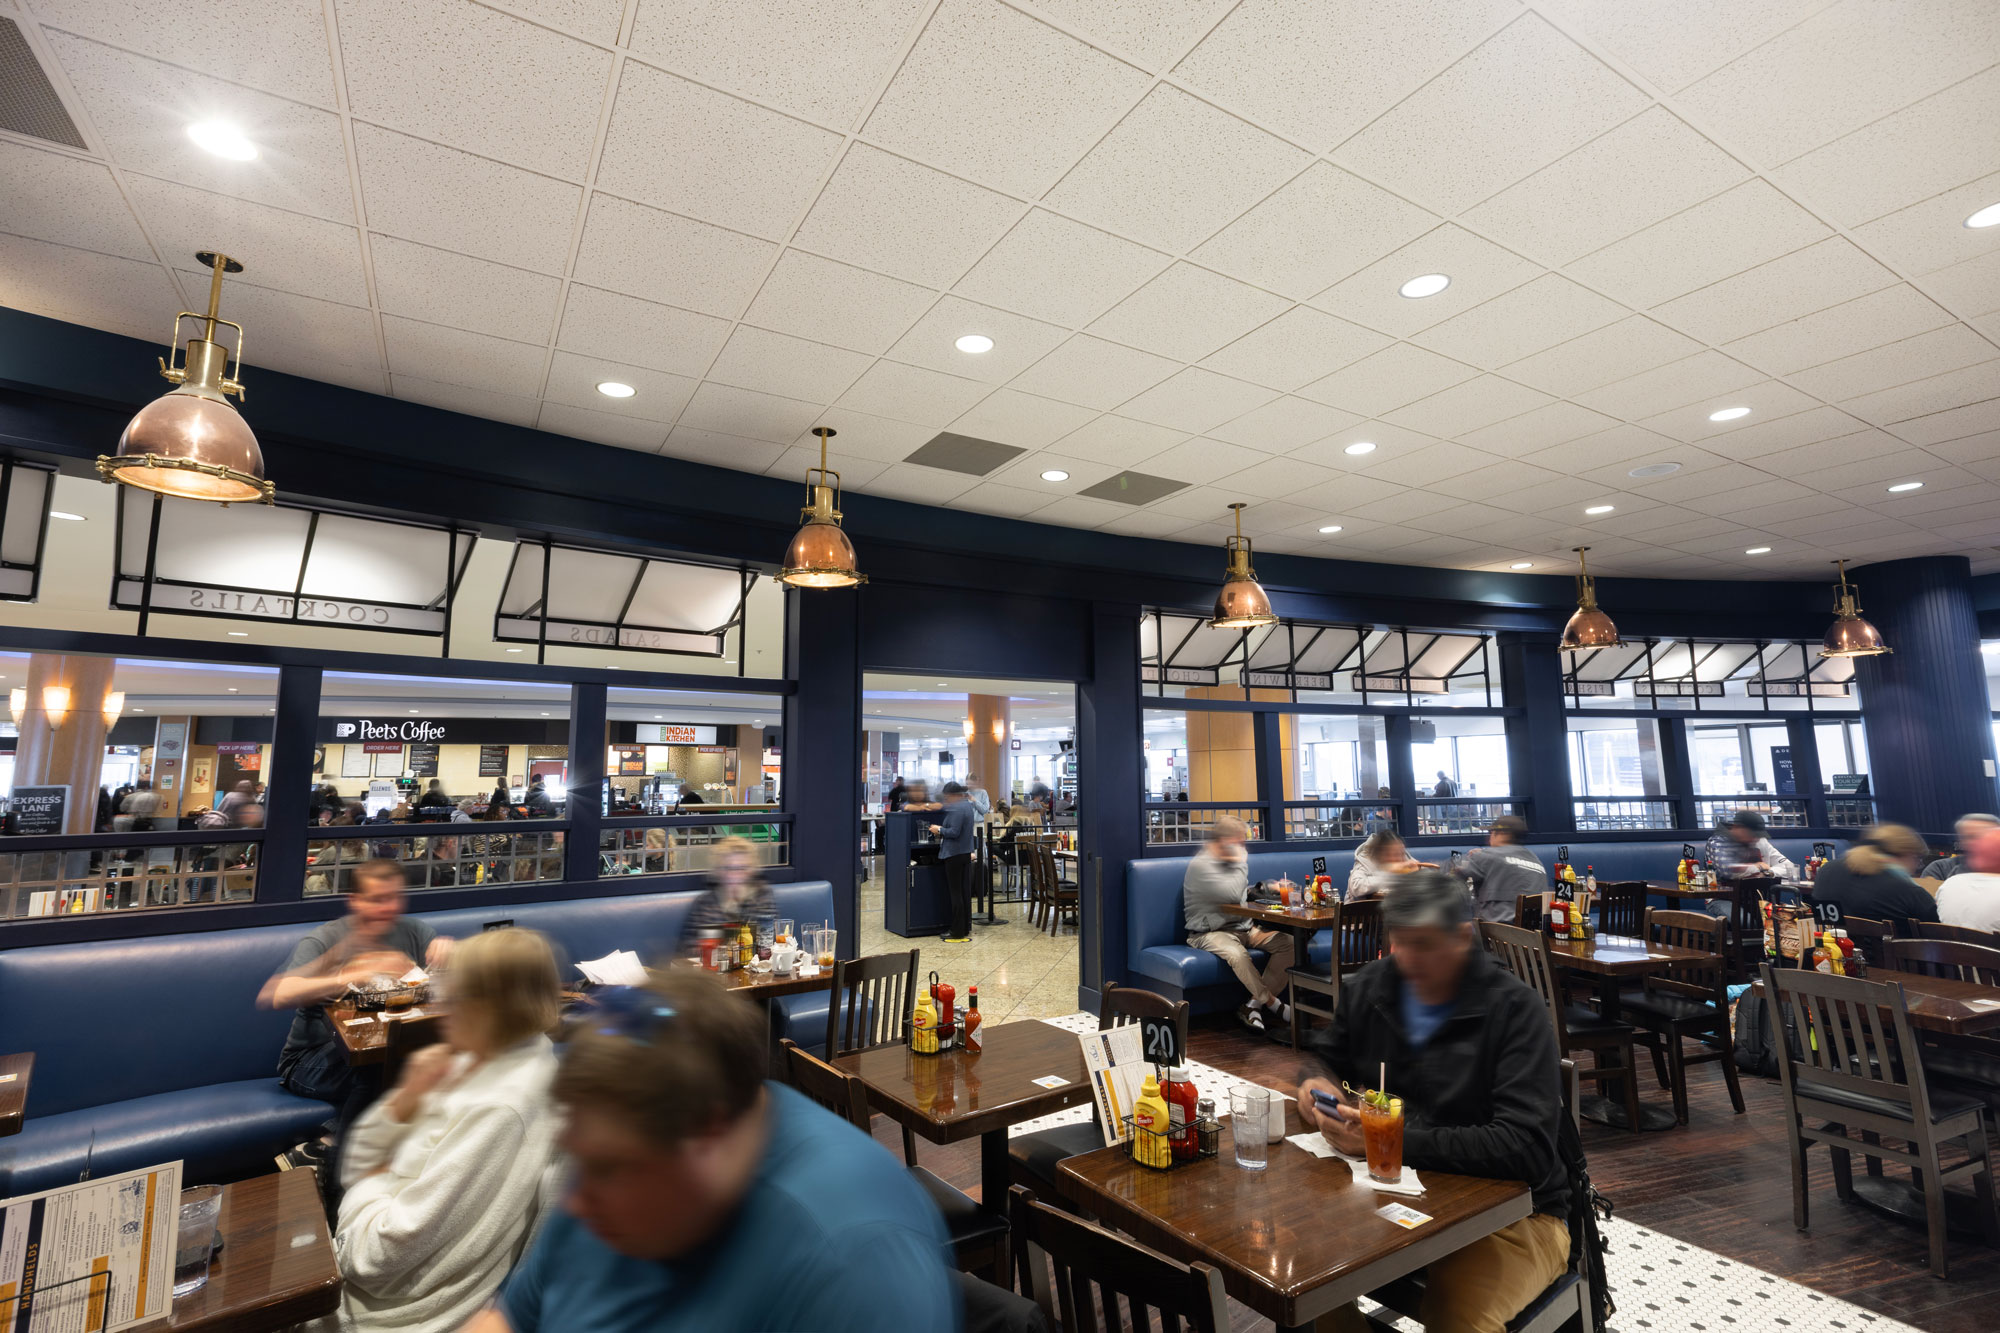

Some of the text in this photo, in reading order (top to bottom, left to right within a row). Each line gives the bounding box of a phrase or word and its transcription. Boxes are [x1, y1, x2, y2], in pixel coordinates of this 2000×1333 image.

[400, 720, 445, 742] Coffee
[13, 796, 61, 805] EXPRESS
[22, 804, 51, 812] LANE
[1684, 845, 1694, 857] 30
[1315, 860, 1324, 872] 33
[1557, 883, 1572, 898] 24
[1816, 903, 1839, 922] 19
[1146, 1023, 1174, 1059] 20
[20, 1242, 38, 1310] HANDHELDS
